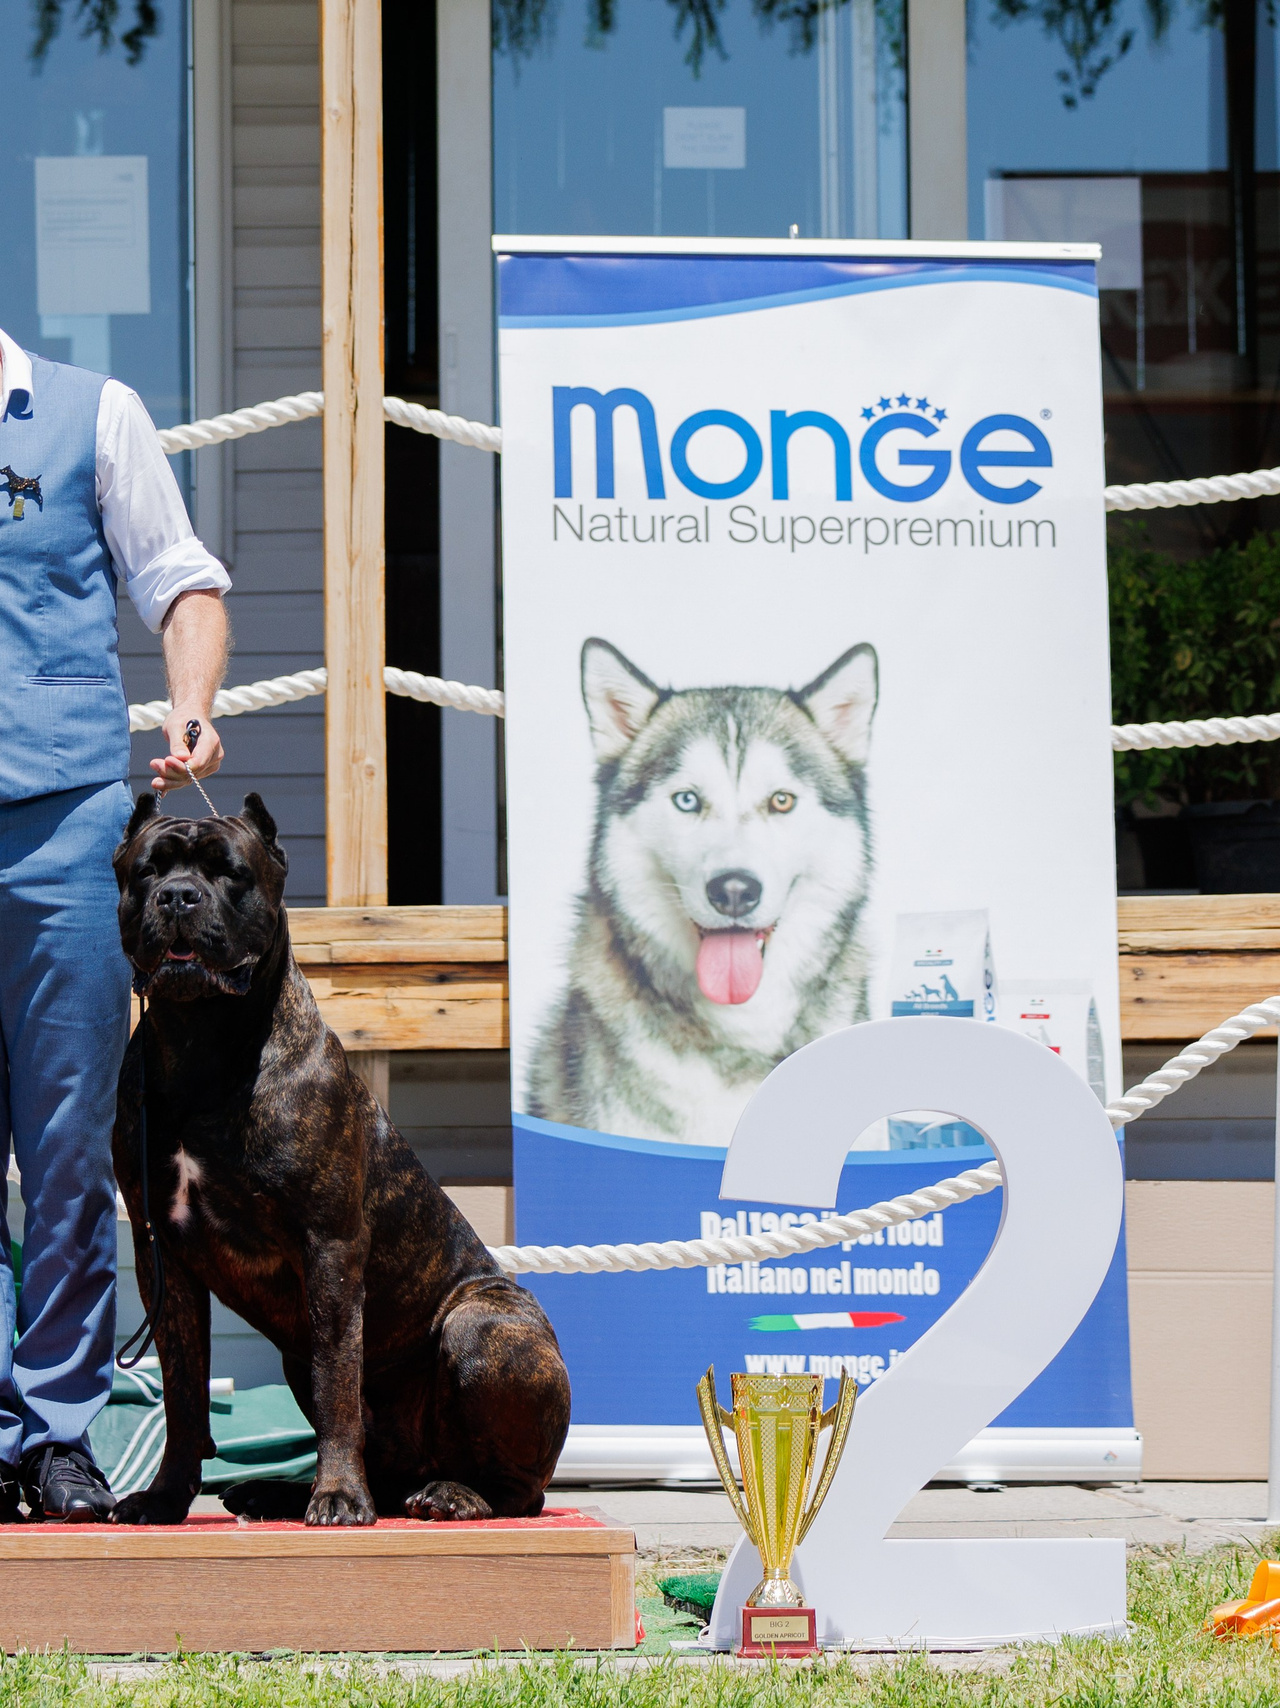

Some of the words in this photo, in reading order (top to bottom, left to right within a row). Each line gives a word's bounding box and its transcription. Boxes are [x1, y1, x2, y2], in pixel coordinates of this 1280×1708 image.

[552, 504, 711, 544] Natural
[728, 504, 1058, 554] Superpremium
[700, 1210, 747, 1240] Dal
[809, 1260, 852, 1295] nel
[853, 1261, 941, 1296] mondo
